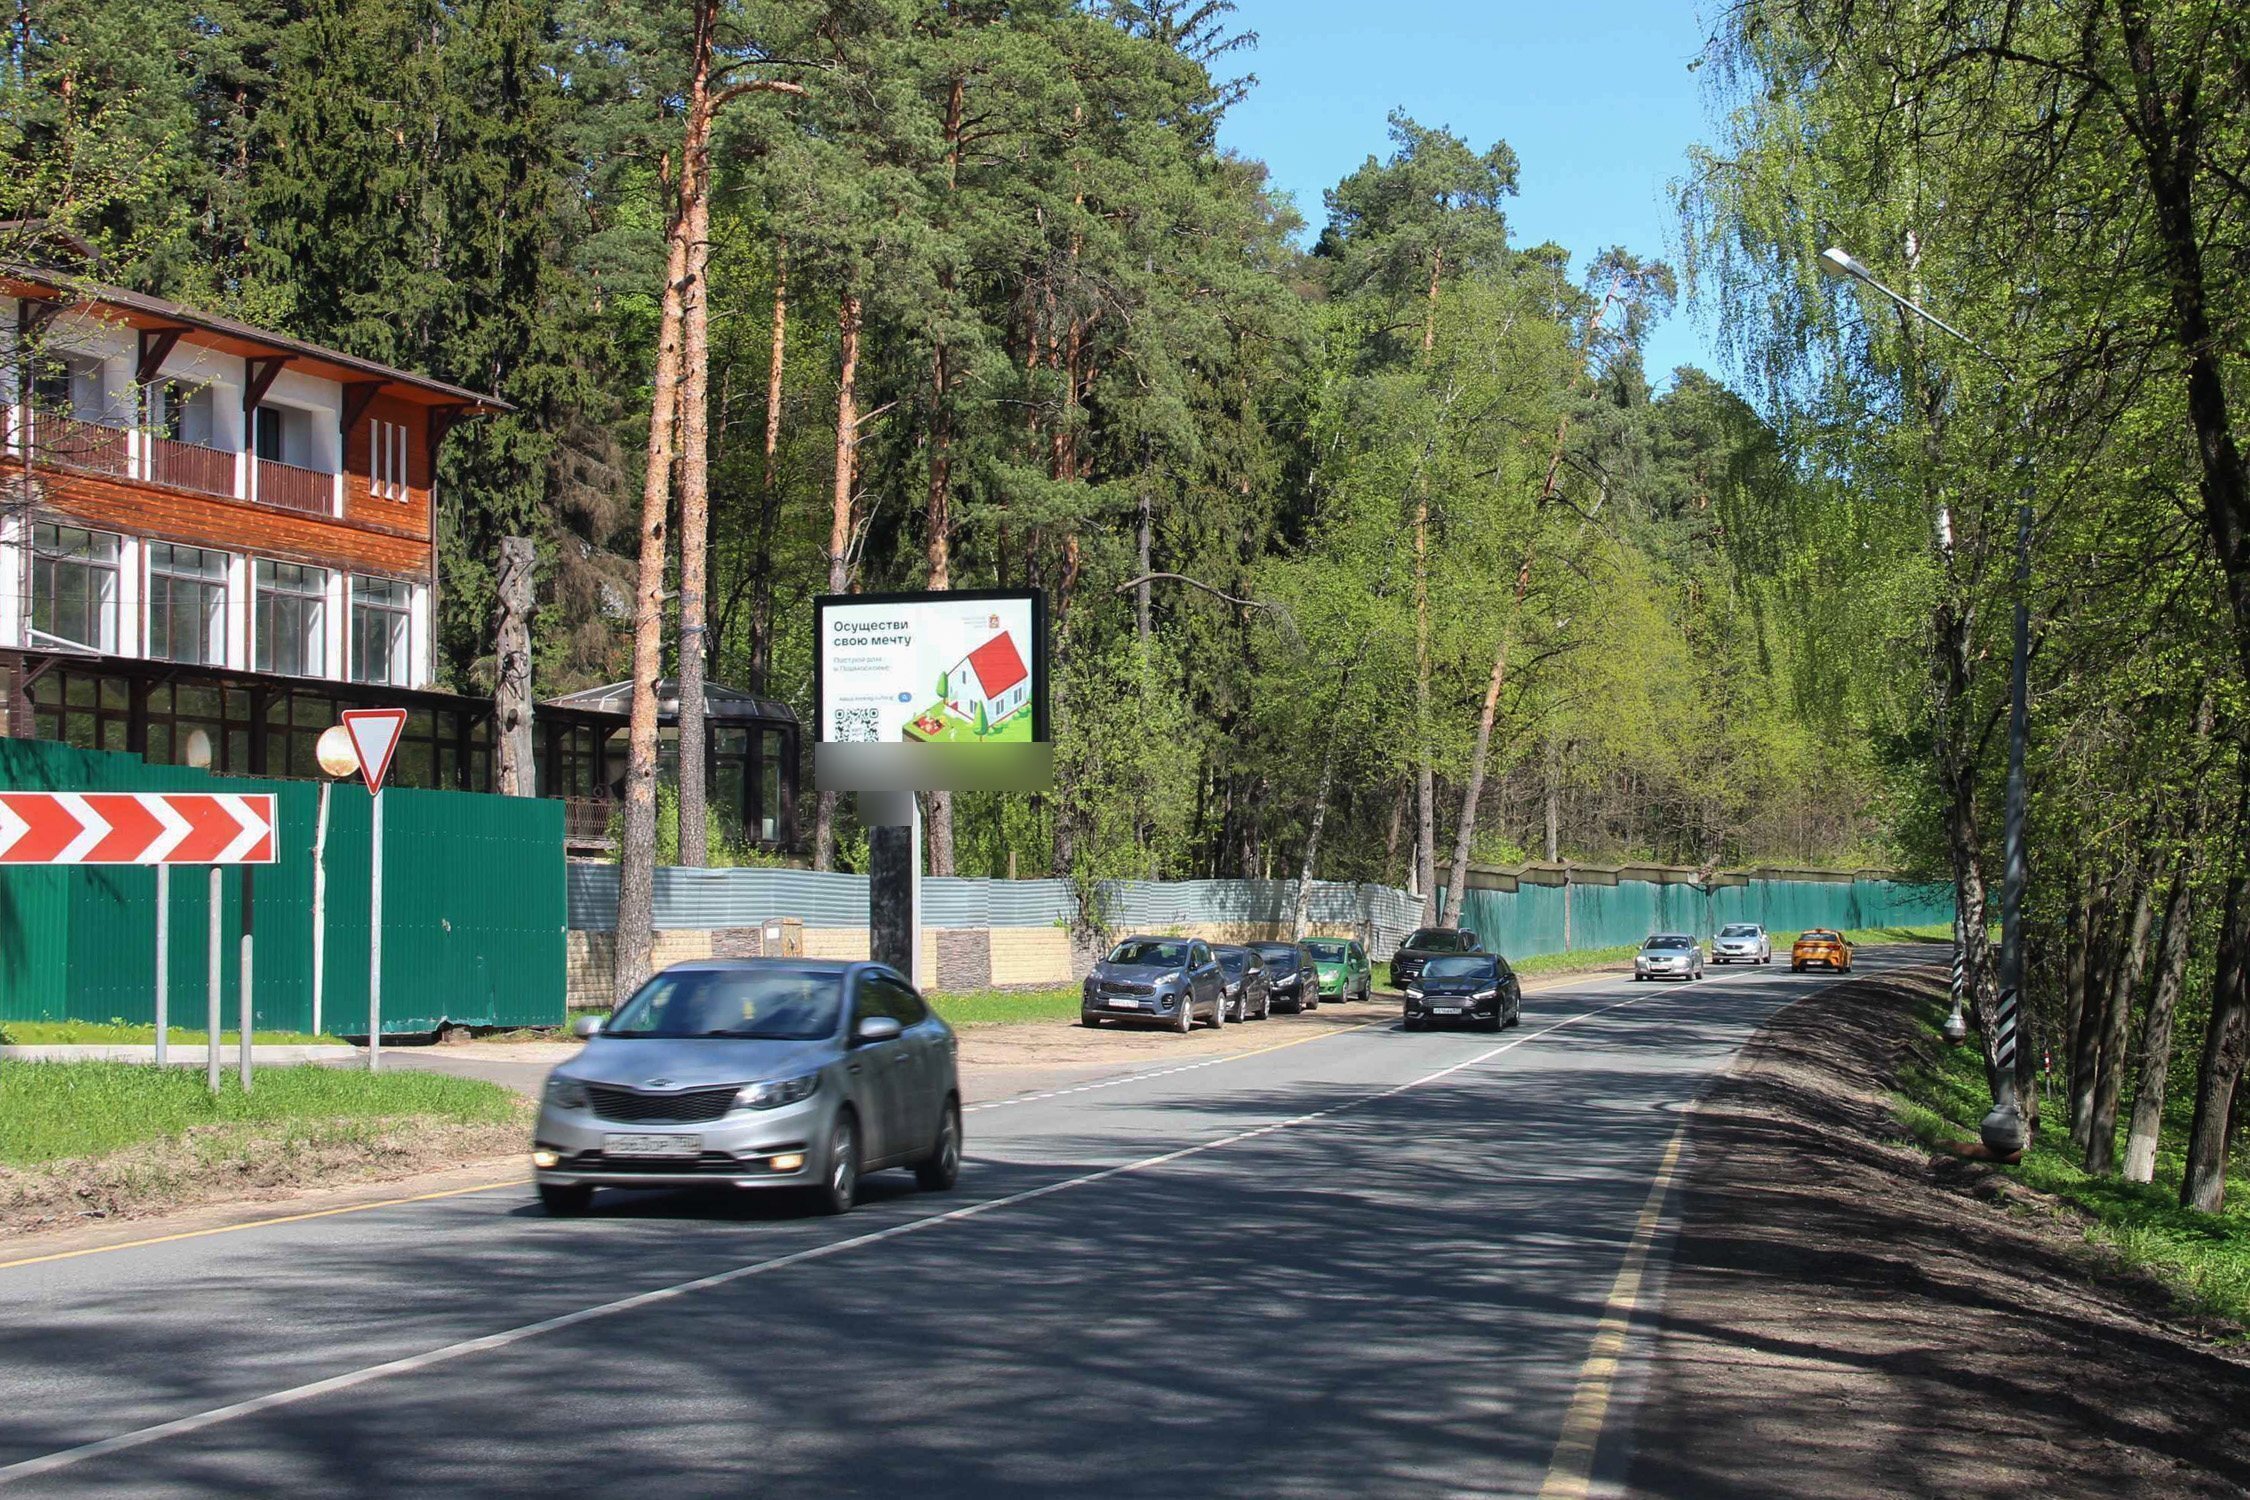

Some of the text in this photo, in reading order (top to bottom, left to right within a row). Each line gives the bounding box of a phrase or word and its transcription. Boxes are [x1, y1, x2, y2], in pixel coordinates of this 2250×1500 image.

[834, 621, 909, 634] Осуществи
[834, 636, 912, 647] свою мечту
